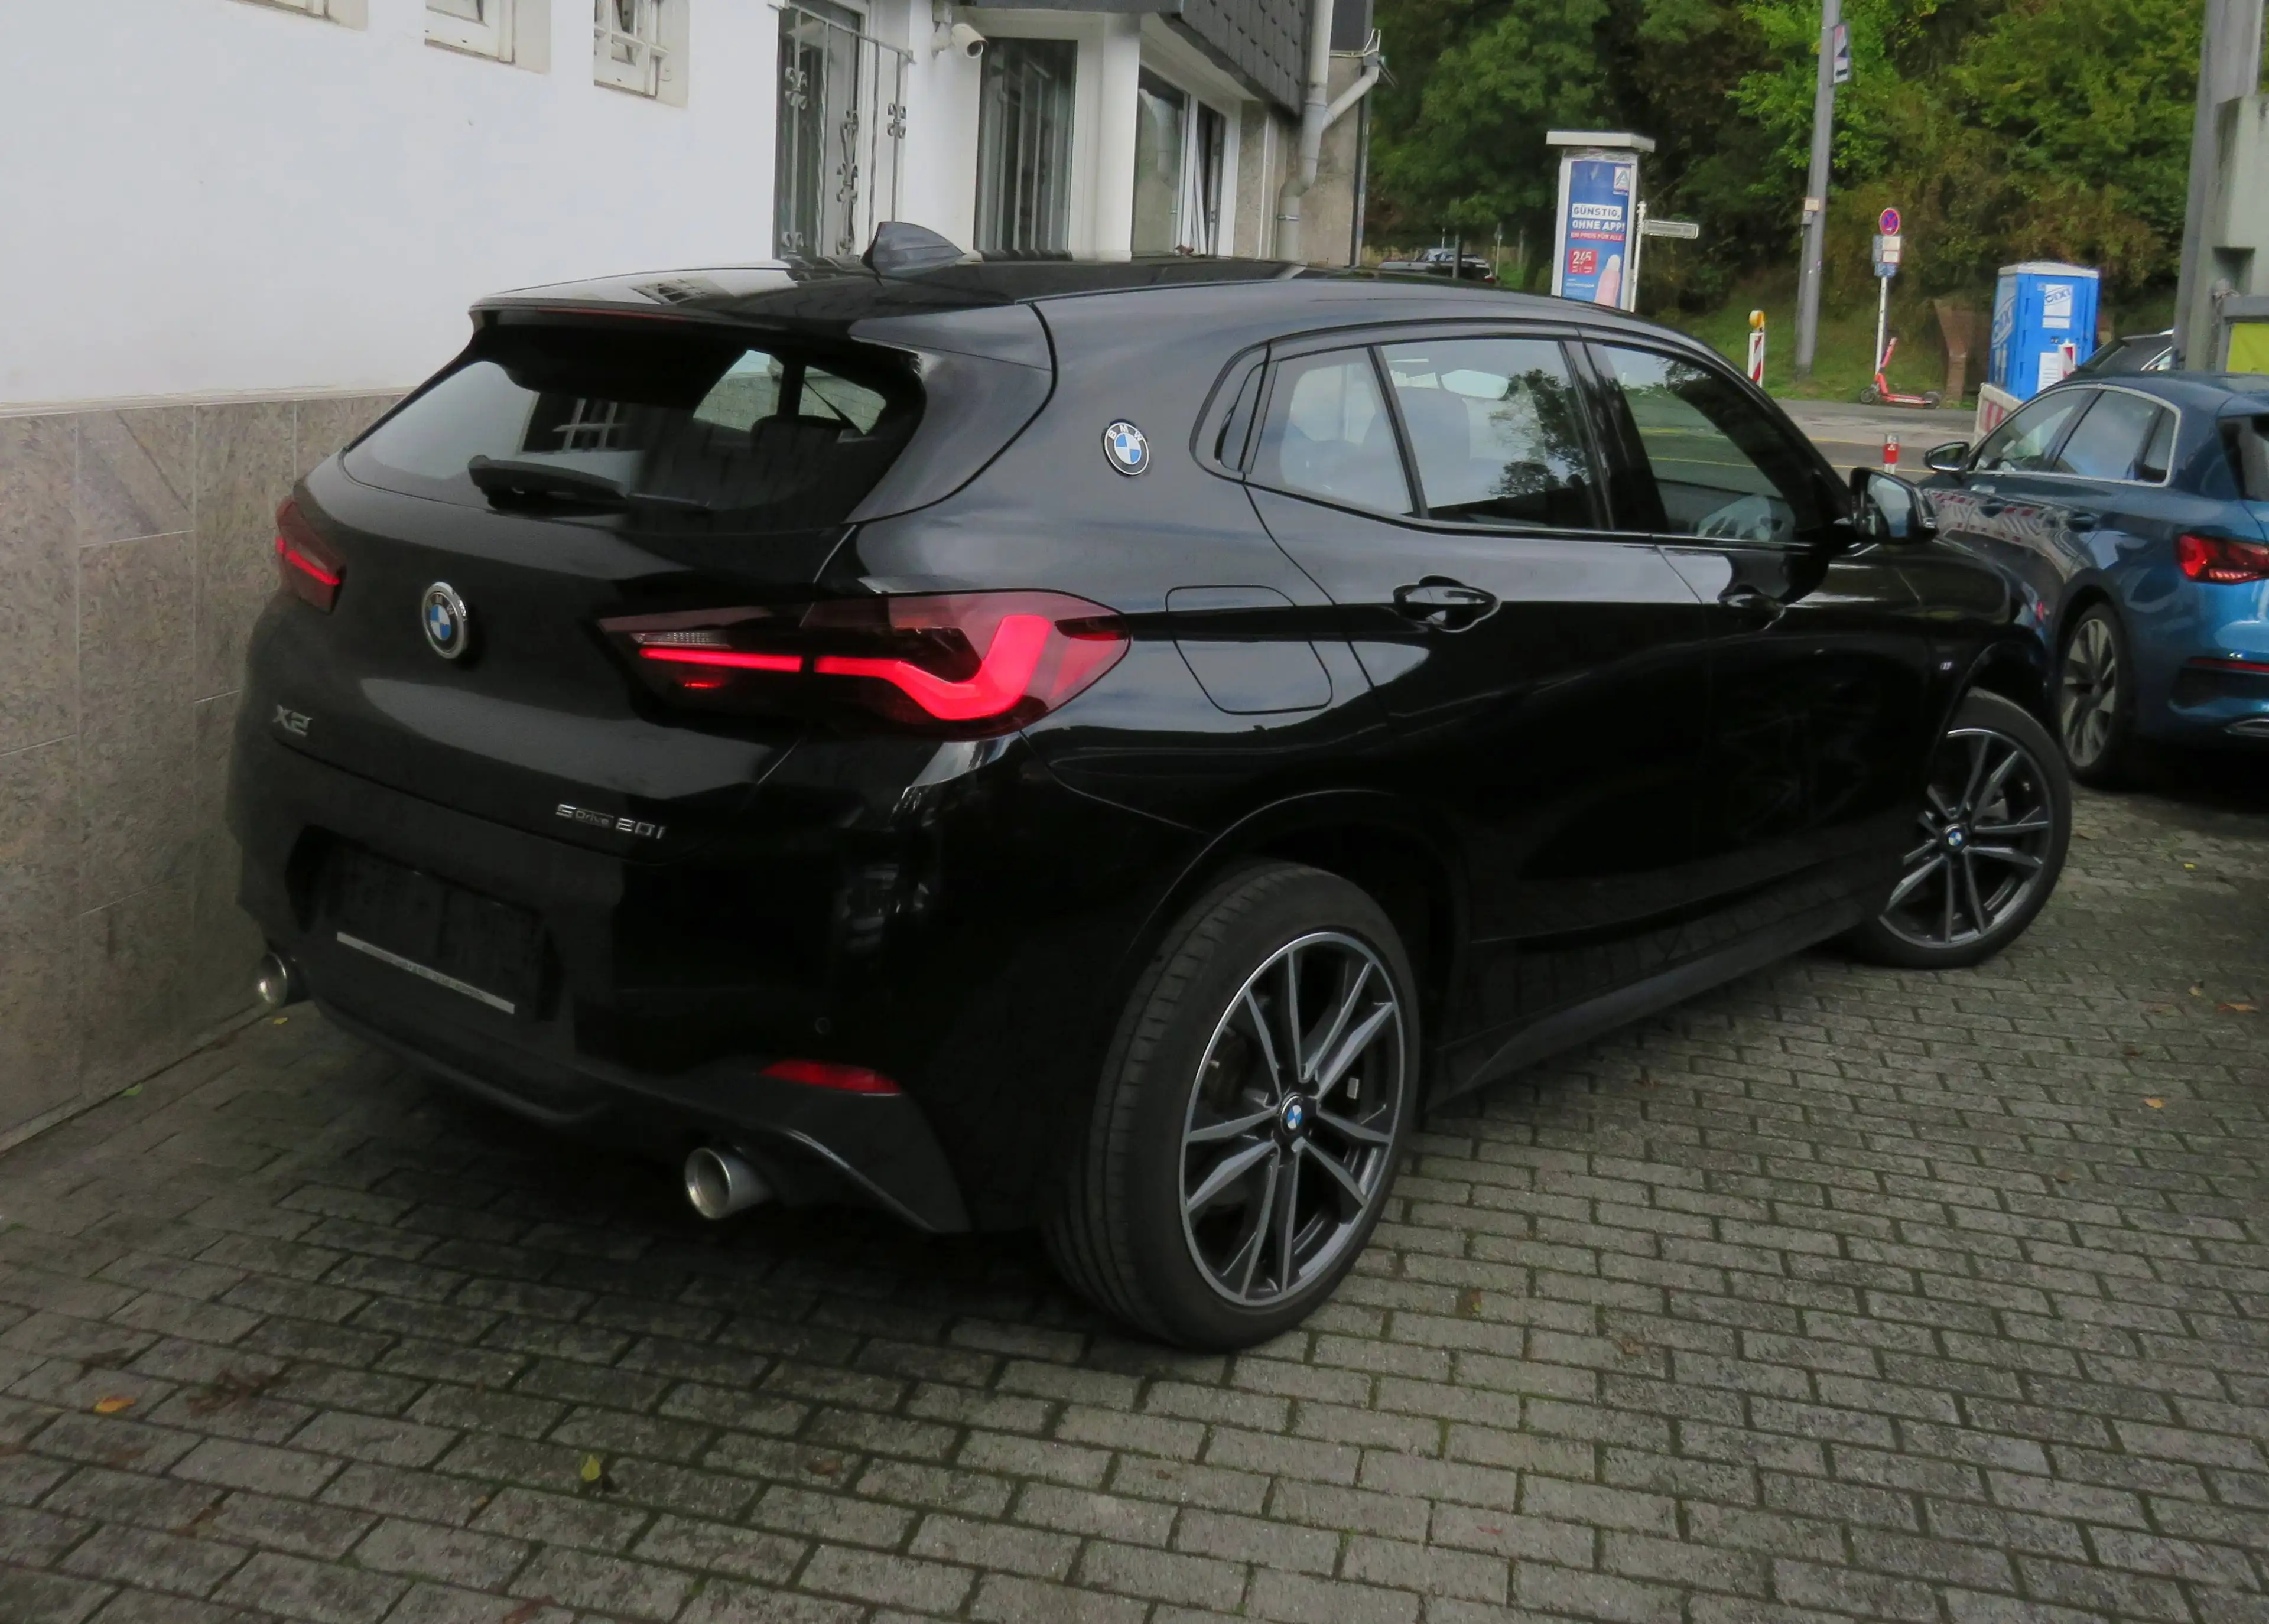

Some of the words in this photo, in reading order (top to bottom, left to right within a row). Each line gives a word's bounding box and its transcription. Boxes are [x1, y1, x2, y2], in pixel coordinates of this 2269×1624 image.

[1572, 220, 1601, 230] OHNE
[1108, 425, 1143, 441] BMW
[272, 704, 311, 738] X2
